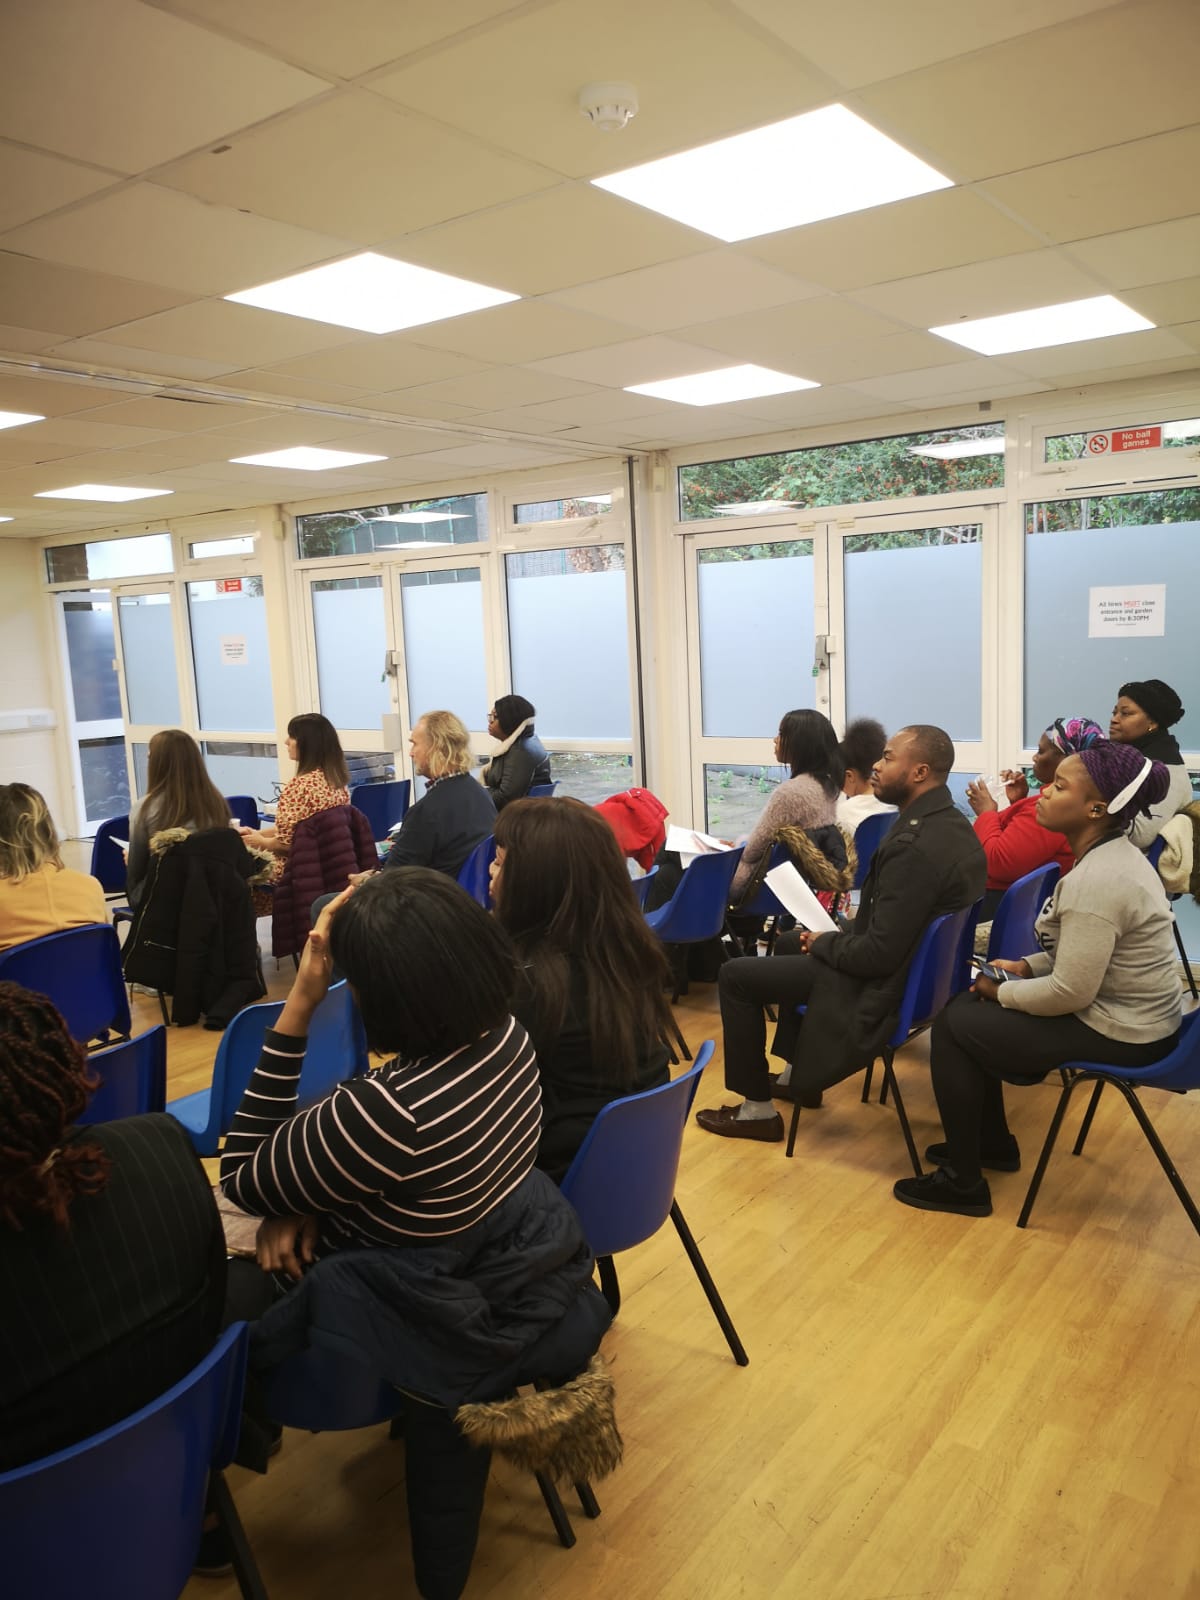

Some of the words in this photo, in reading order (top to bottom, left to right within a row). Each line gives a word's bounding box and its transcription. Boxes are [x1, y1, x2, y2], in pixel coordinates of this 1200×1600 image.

[1122, 432, 1133, 441] No
[1136, 430, 1151, 439] ball
[1122, 439, 1150, 449] games
[1135, 607, 1153, 615] garden
